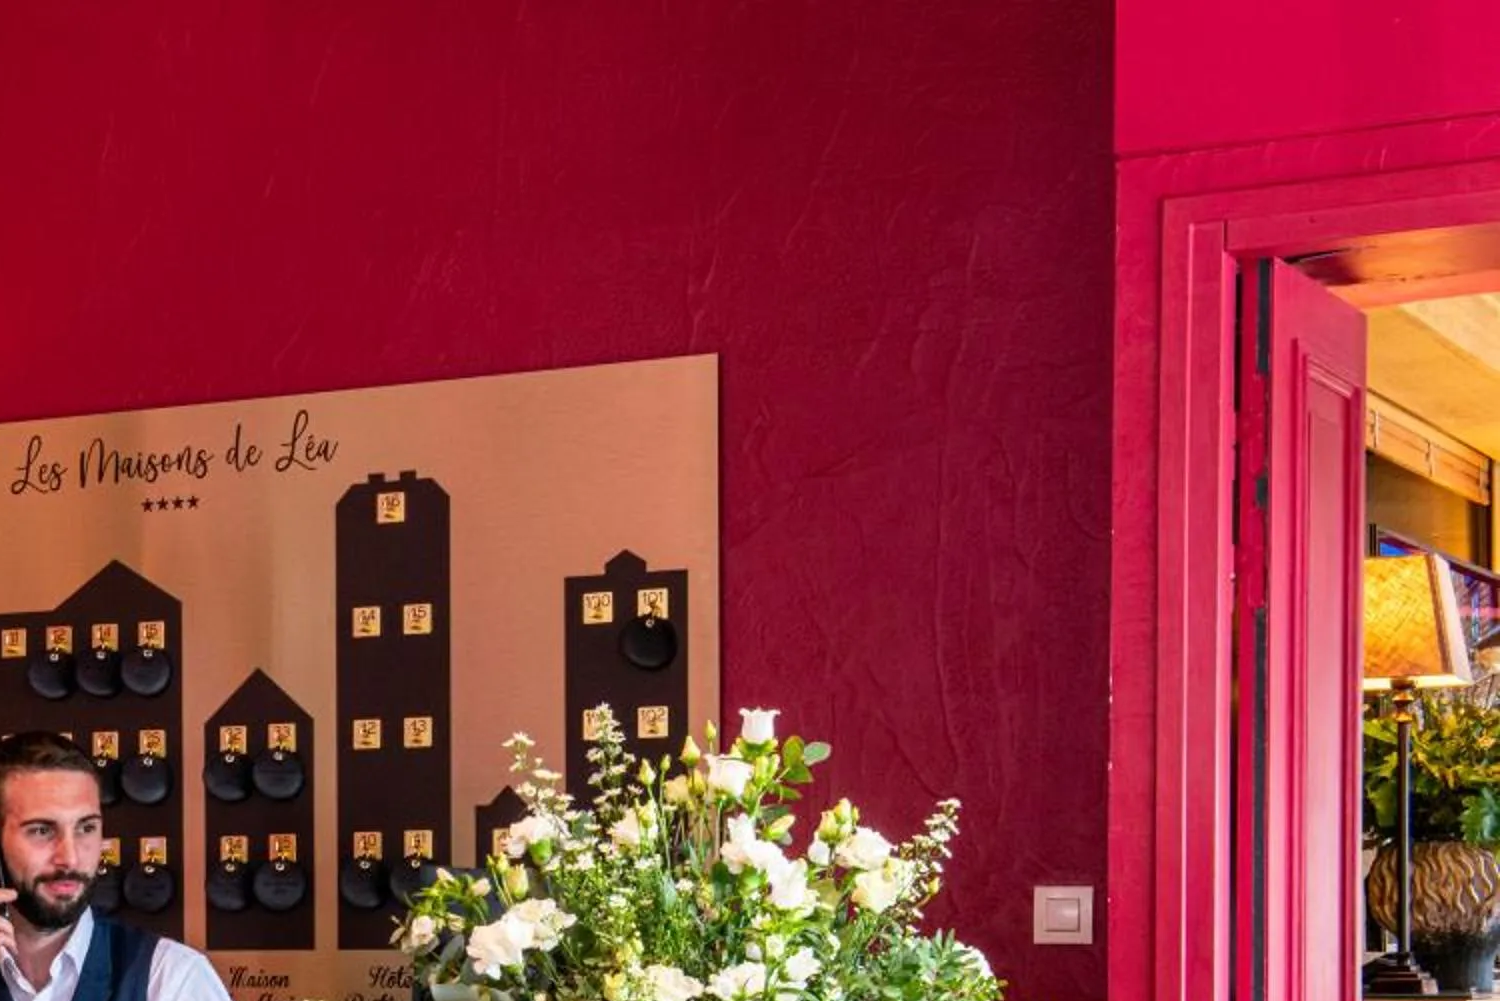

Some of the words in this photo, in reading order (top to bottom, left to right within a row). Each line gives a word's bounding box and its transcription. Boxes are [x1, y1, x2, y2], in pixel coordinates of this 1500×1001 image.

[11, 434, 67, 495] Les
[78, 437, 215, 488] Maisons
[225, 423, 264, 473] de
[275, 409, 339, 473] Léa
[229, 966, 289, 988] Maison
